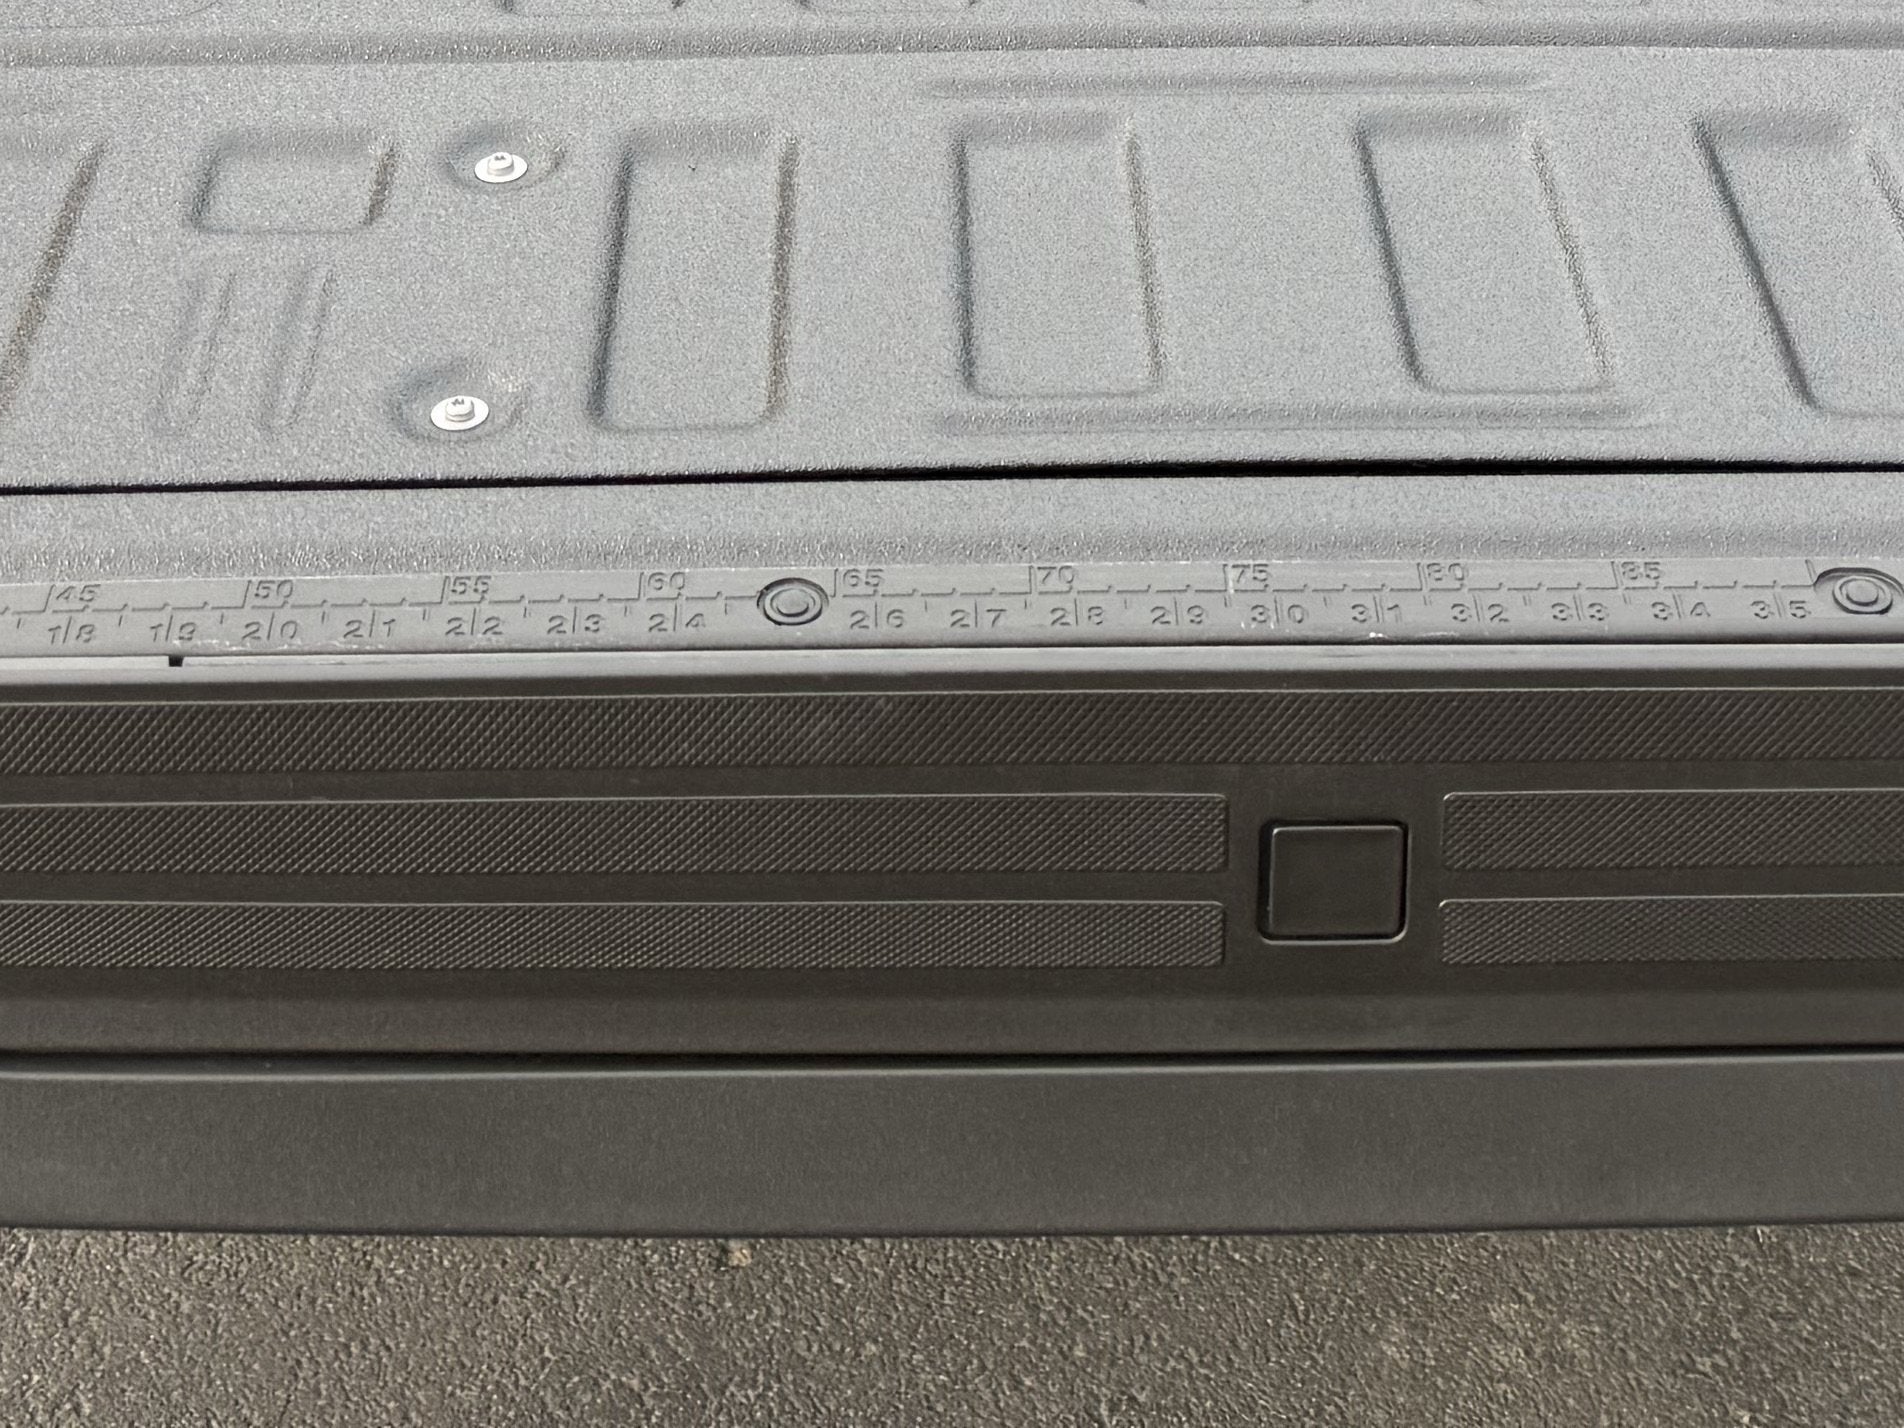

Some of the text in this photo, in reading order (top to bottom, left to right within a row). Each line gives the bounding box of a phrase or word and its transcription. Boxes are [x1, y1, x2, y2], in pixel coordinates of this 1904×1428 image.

[55, 583, 102, 604] 45
[253, 578, 295, 600] 50
[449, 574, 493, 596] 55
[647, 571, 687, 592] 60
[842, 567, 886, 589] 65
[1036, 564, 1078, 586] 70
[1231, 563, 1272, 585] 75
[1426, 562, 1471, 584] 80
[1620, 560, 1664, 582] 85
[47, 623, 97, 645] 18
[149, 621, 198, 644] 19
[240, 619, 300, 642] 20
[342, 618, 398, 640] 21
[444, 616, 506, 637] 22
[546, 614, 606, 635] 23
[647, 612, 709, 634] 24
[848, 608, 907, 631] 26
[949, 608, 1009, 630] 27
[1049, 606, 1106, 628] 28
[1149, 604, 1209, 627] 29
[1249, 603, 1311, 626] 30
[1349, 602, 1405, 625] 31
[1450, 601, 1512, 624] 32
[1550, 600, 1611, 623] 33
[1650, 599, 1714, 622] 34
[1750, 598, 1815, 621] 35
